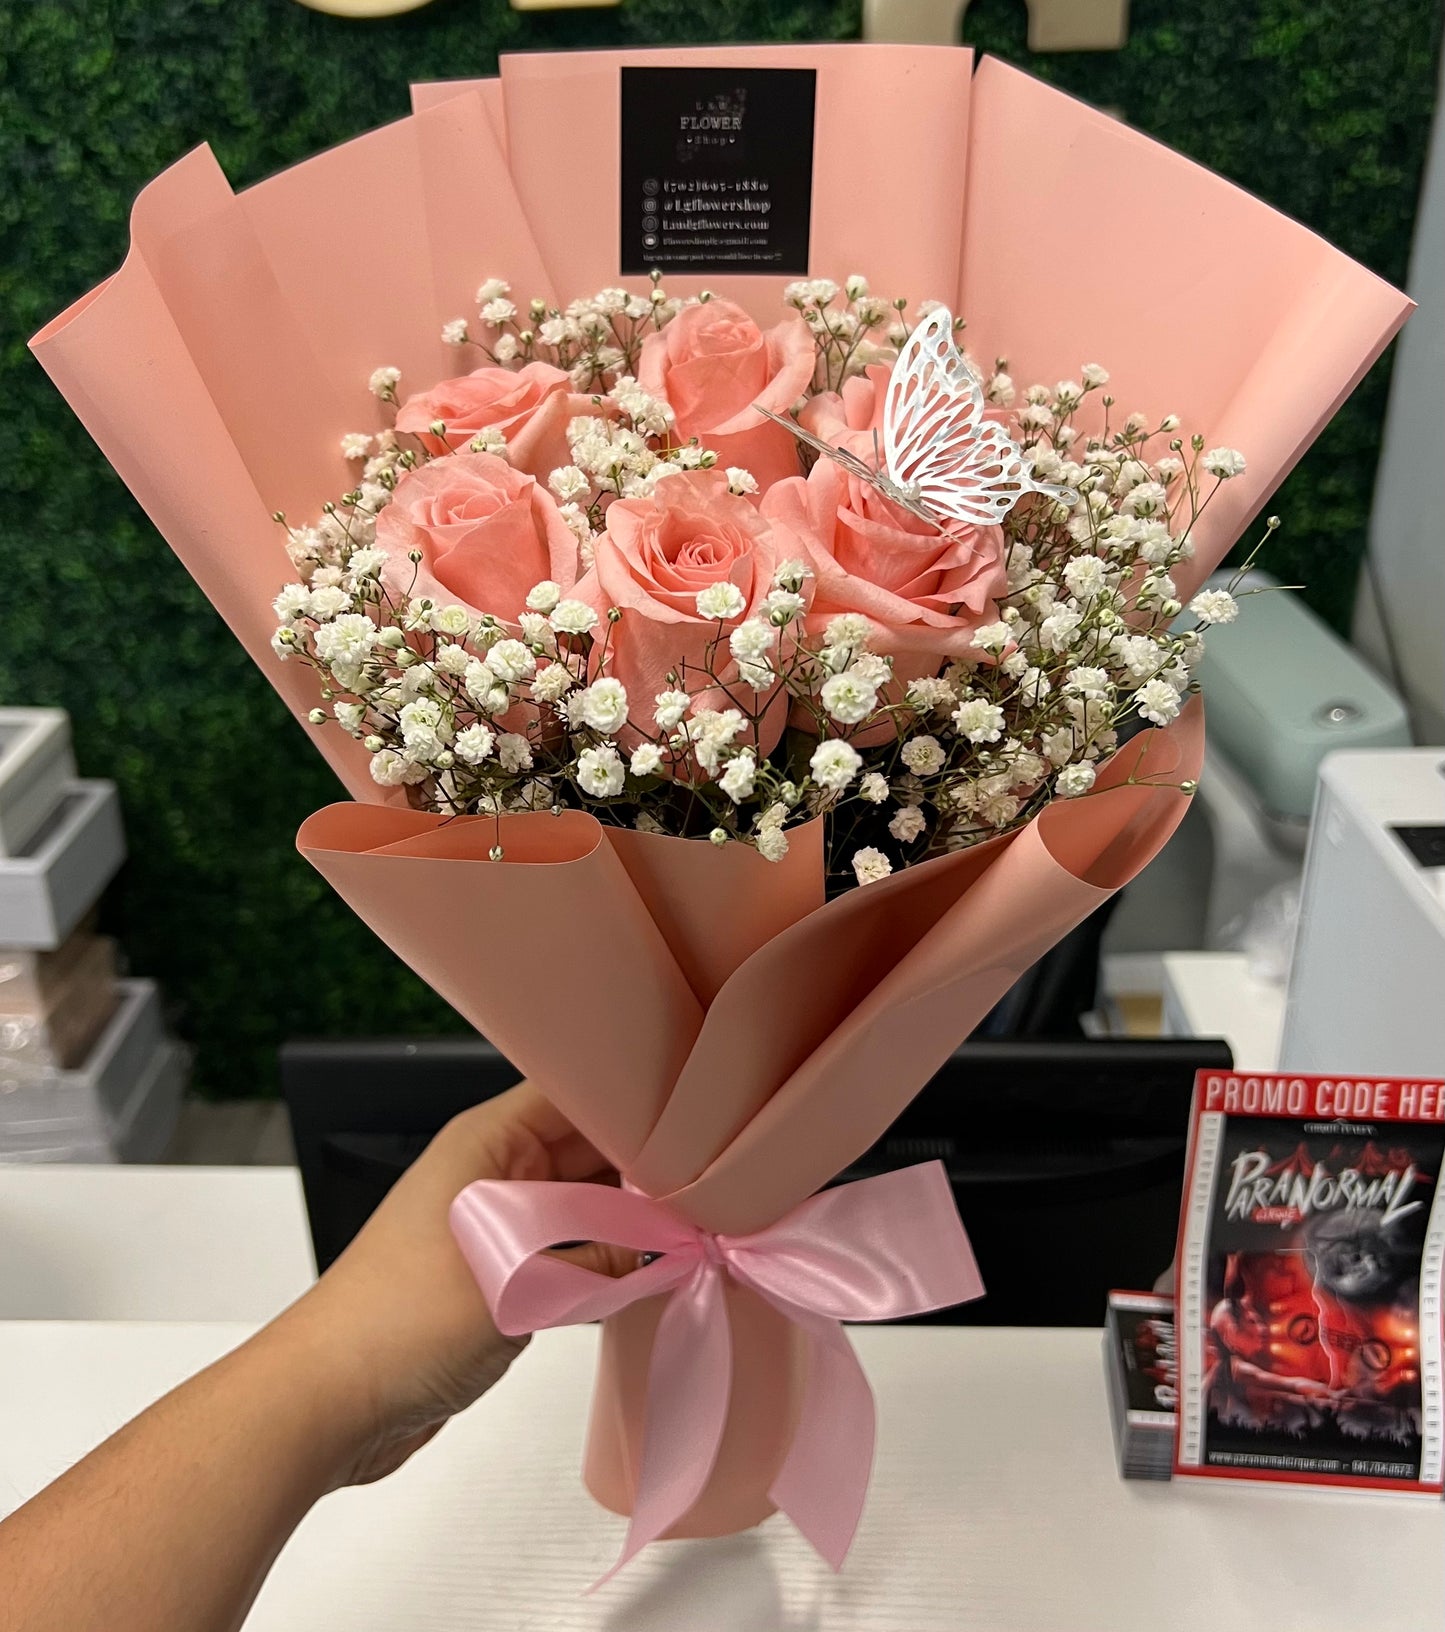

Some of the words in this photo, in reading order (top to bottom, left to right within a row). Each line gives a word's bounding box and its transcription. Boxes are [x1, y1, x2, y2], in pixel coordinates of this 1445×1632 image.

[680, 116, 742, 131] FLOWER
[1206, 1076, 1308, 1113] PROMO
[1315, 1080, 1391, 1117] CODE
[1224, 1150, 1425, 1230] PARANORMAL
